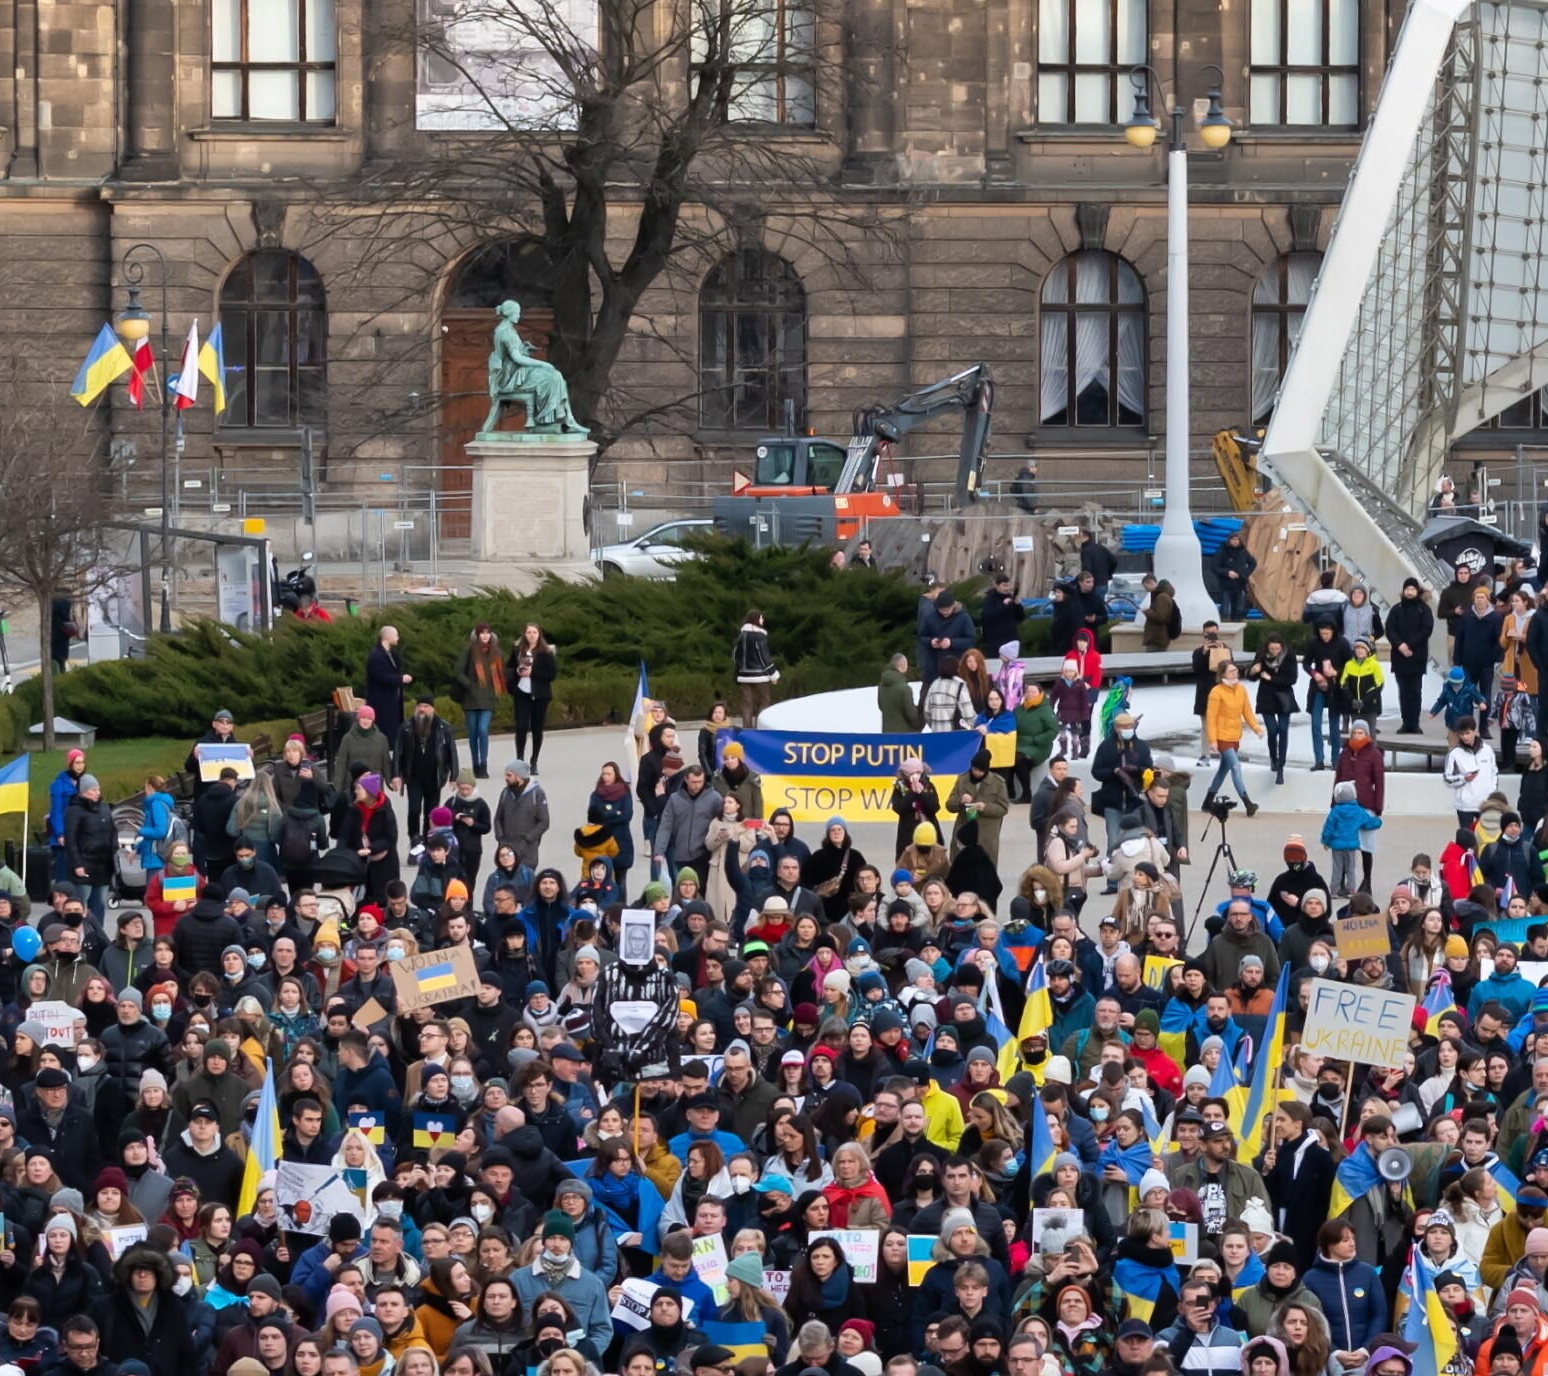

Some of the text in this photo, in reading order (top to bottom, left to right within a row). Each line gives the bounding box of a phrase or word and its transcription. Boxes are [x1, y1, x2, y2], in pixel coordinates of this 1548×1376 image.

[784, 743, 922, 770] STOP PUTIN
[786, 785, 898, 812] STOP WA
[1314, 987, 1405, 1030] FREE
[1303, 1030, 1409, 1067] UKRAINE
